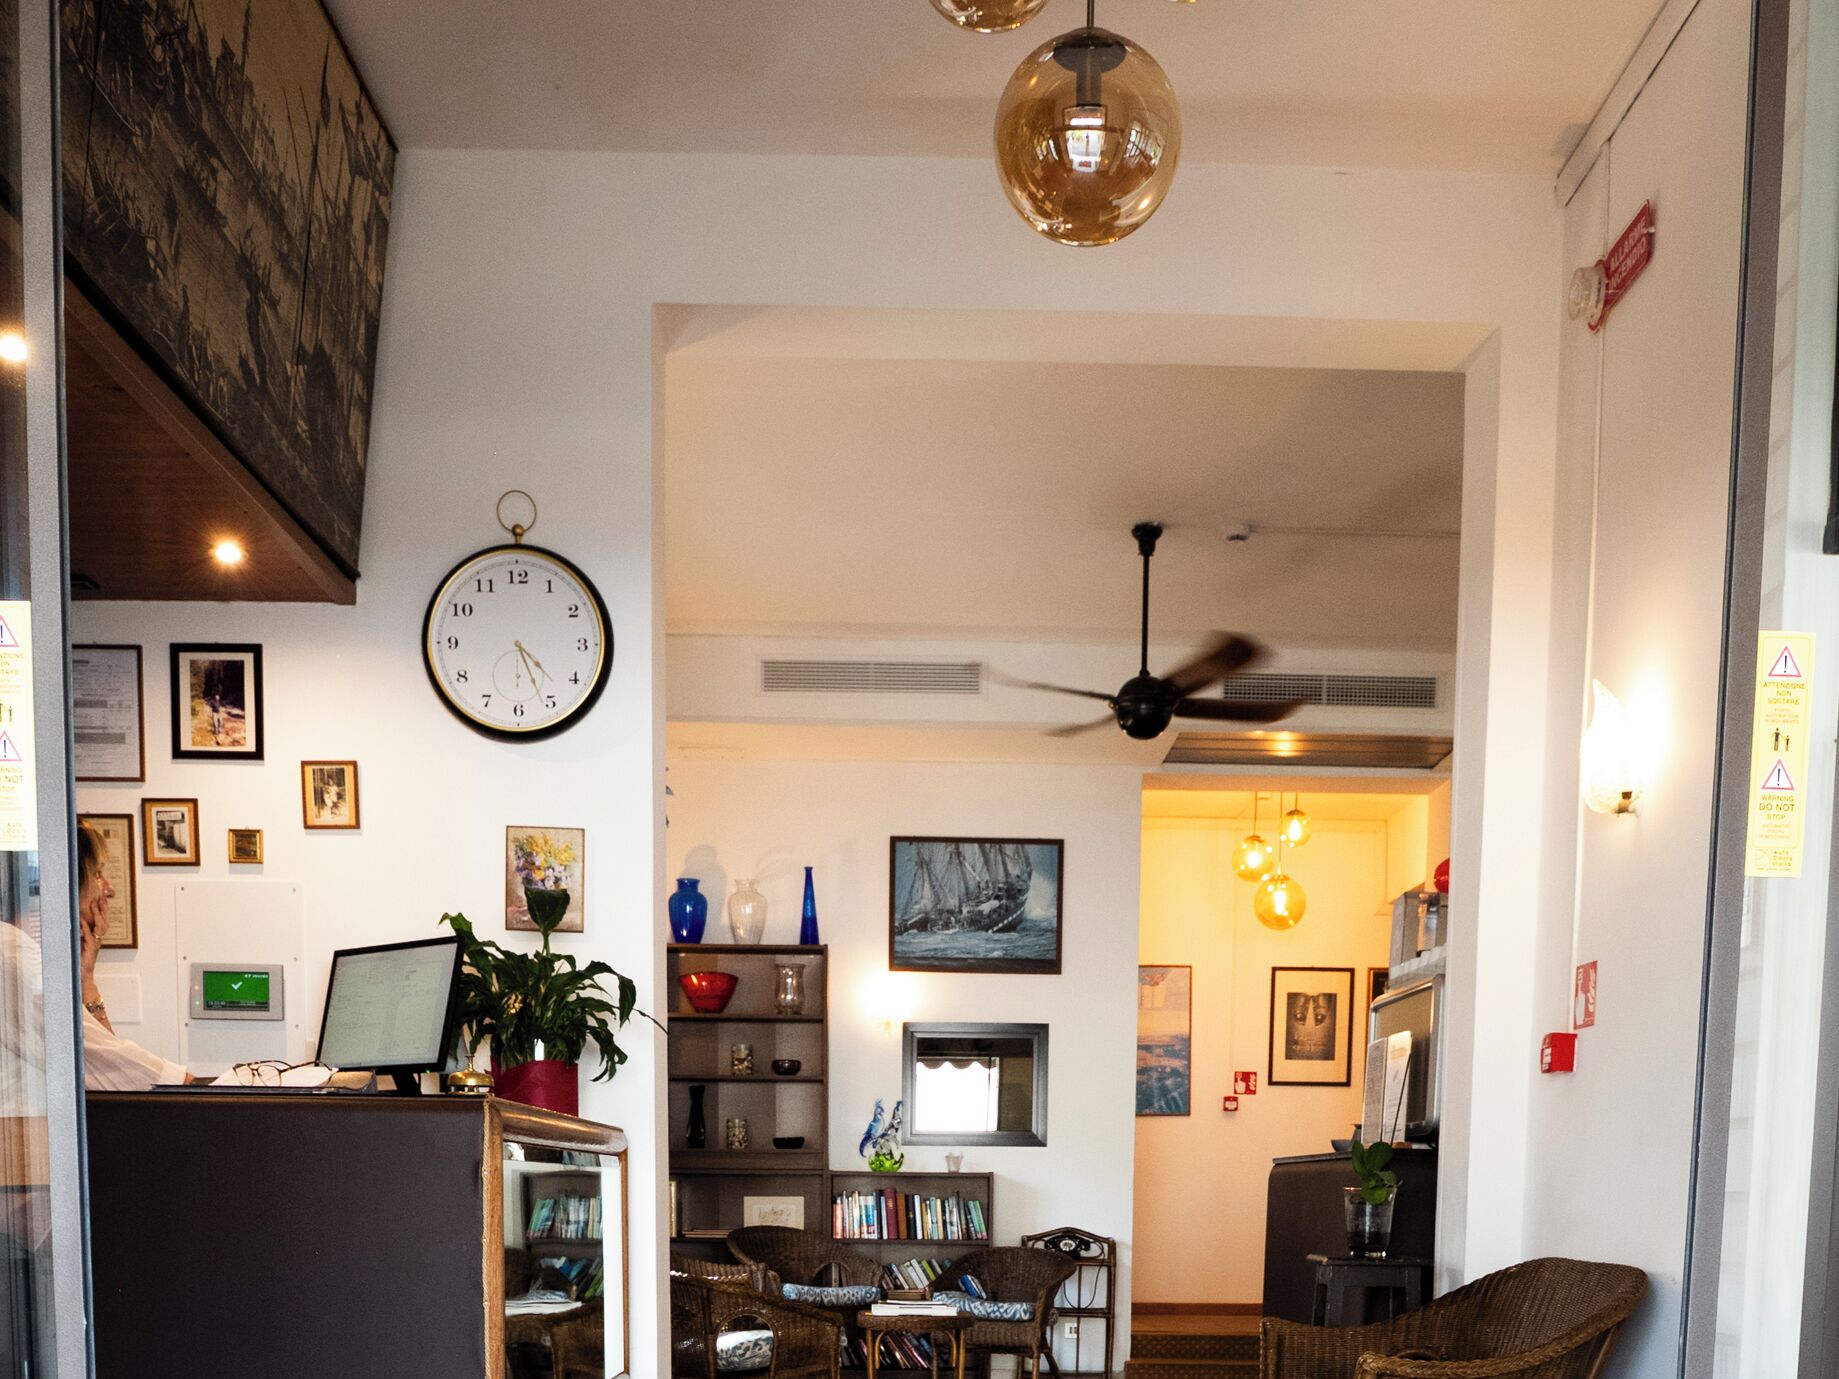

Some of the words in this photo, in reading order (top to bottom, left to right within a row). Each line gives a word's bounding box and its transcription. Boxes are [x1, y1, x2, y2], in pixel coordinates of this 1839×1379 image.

[1610, 217, 1648, 271] ALLARME
[1608, 237, 1646, 289] INCENDIO
[508, 570, 528, 584] 12
[476, 579, 495, 593] 11
[546, 580, 553, 593] 1
[452, 603, 473, 617] 10
[568, 604, 579, 618] 2
[448, 636, 458, 649] 9
[577, 638, 588, 651] 3
[457, 671, 468, 683] 8
[569, 672, 579, 685] 4
[482, 694, 492, 708] 7
[546, 696, 556, 709] 5
[514, 704, 524, 717] 6
[1759, 803, 1773, 811] DO
[1776, 803, 1795, 812] NOT
